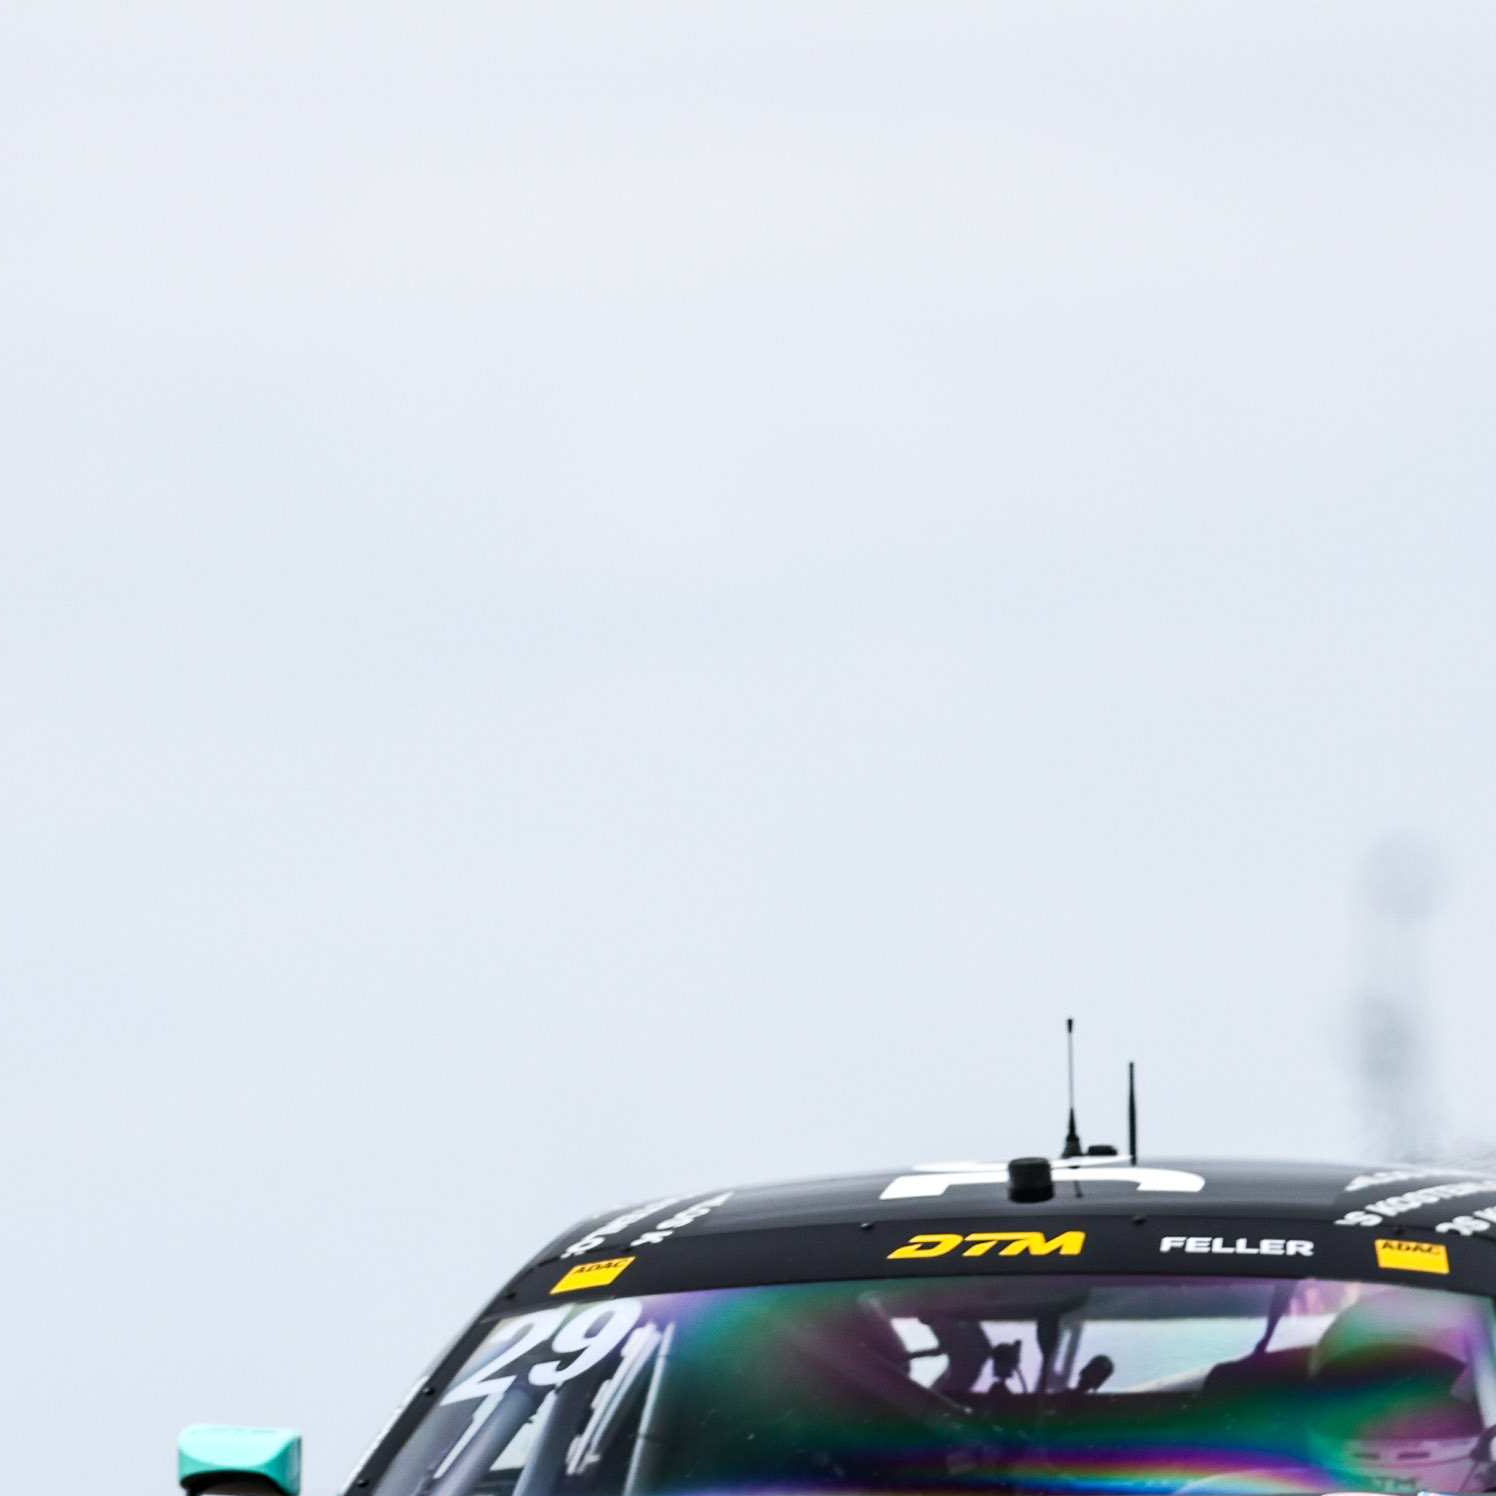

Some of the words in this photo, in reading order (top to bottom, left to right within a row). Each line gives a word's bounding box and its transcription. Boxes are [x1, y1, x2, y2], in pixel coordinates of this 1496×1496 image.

[886, 1230, 1086, 1259] DTM
[1159, 1237, 1314, 1257] FELLER
[1380, 1239, 1442, 1256] ADAC
[572, 1259, 630, 1275] ADAC
[438, 1299, 643, 1406] 29
